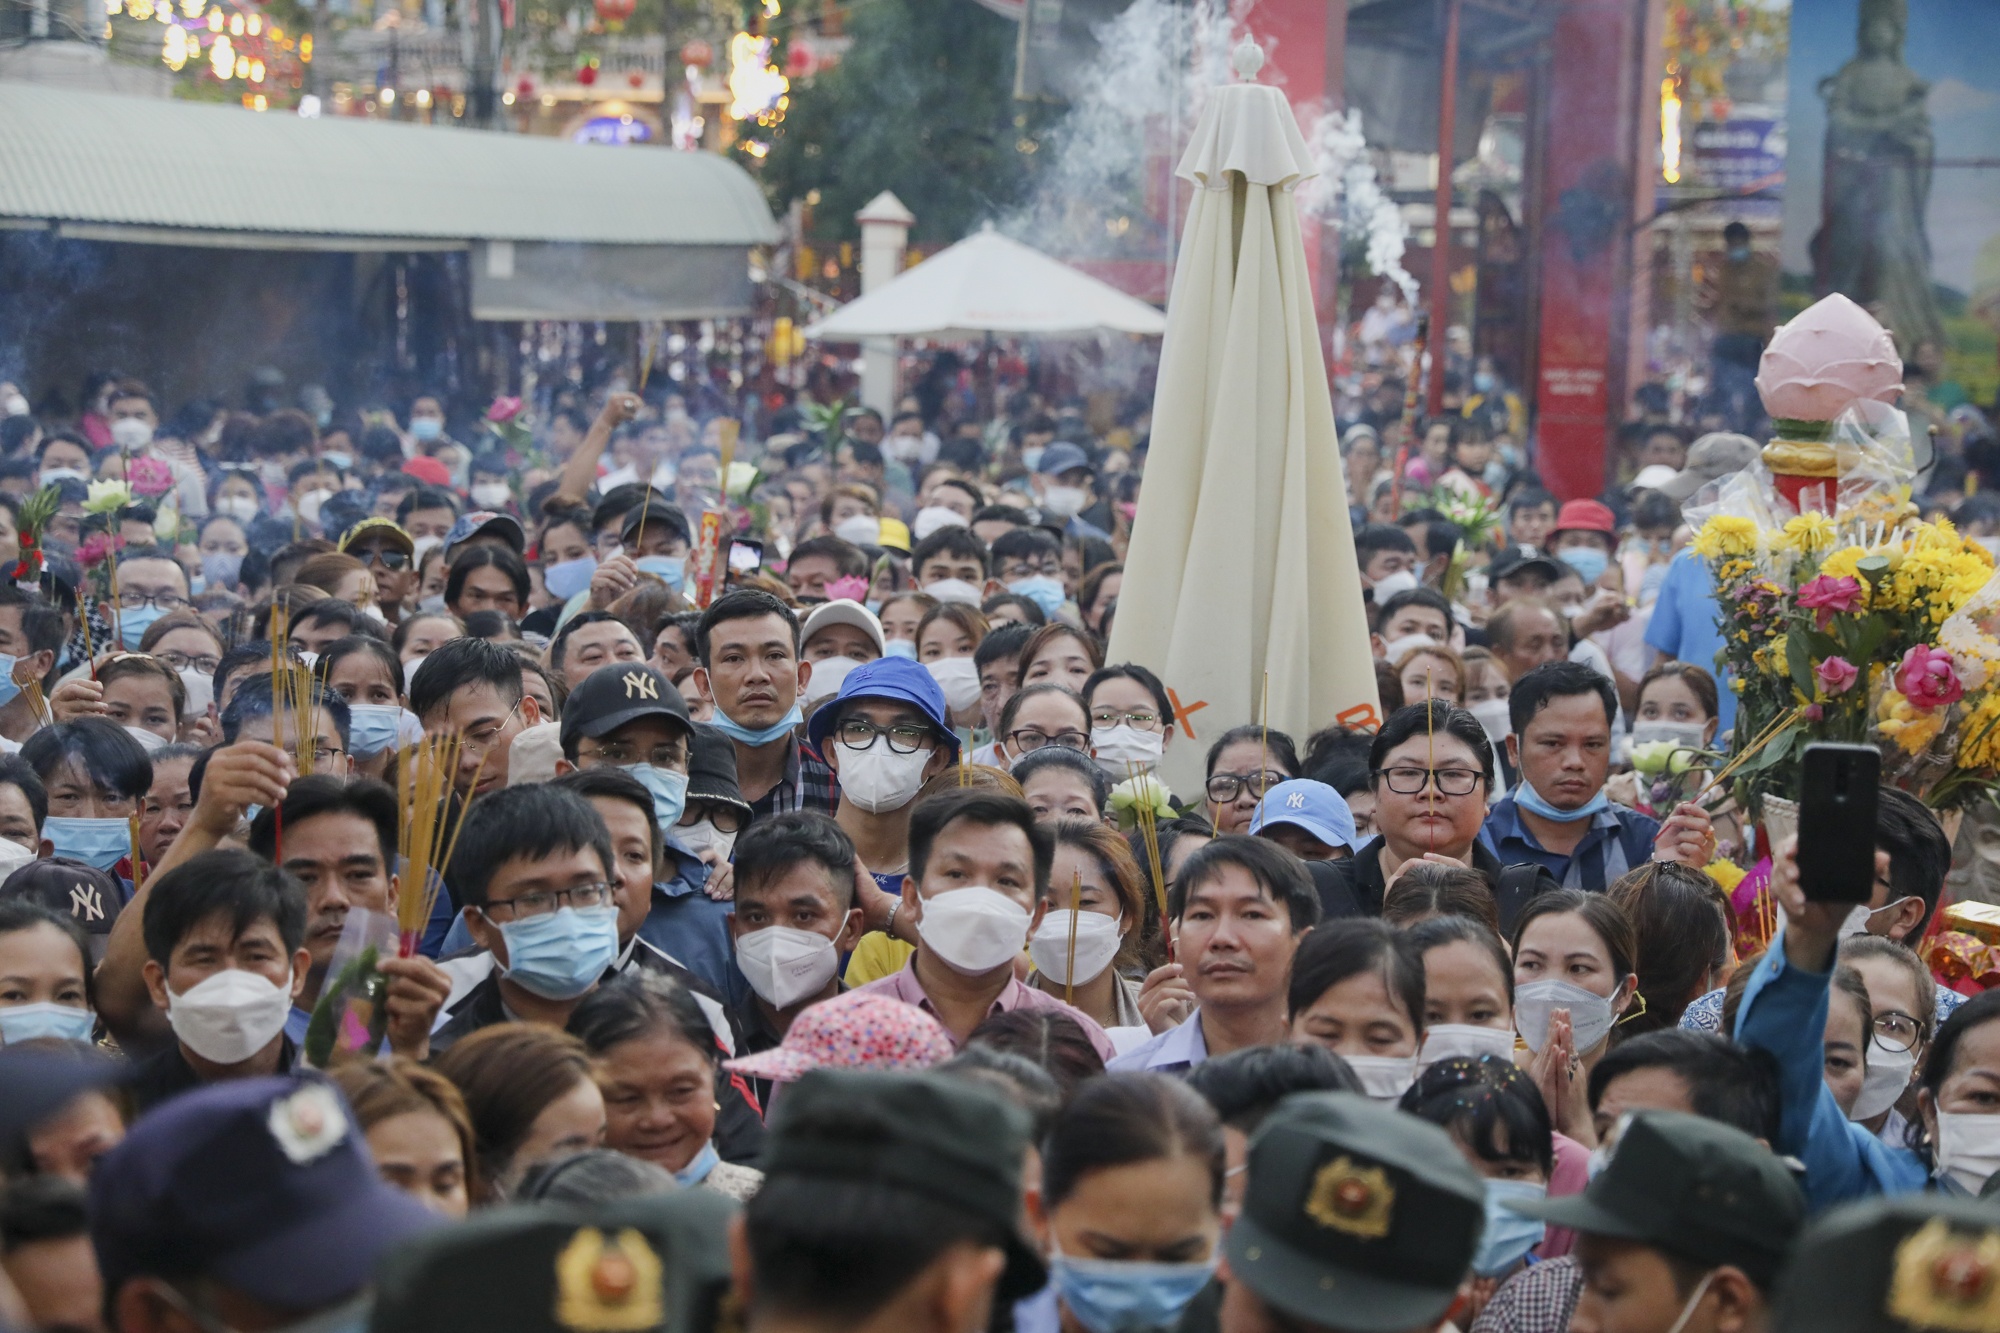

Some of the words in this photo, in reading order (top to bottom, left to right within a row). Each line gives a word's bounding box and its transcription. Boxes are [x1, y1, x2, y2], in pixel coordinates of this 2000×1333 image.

[622, 671, 659, 700] NY
[1166, 686, 1209, 740] X
[1286, 792, 1305, 808] NY
[69, 883, 105, 921] NY
